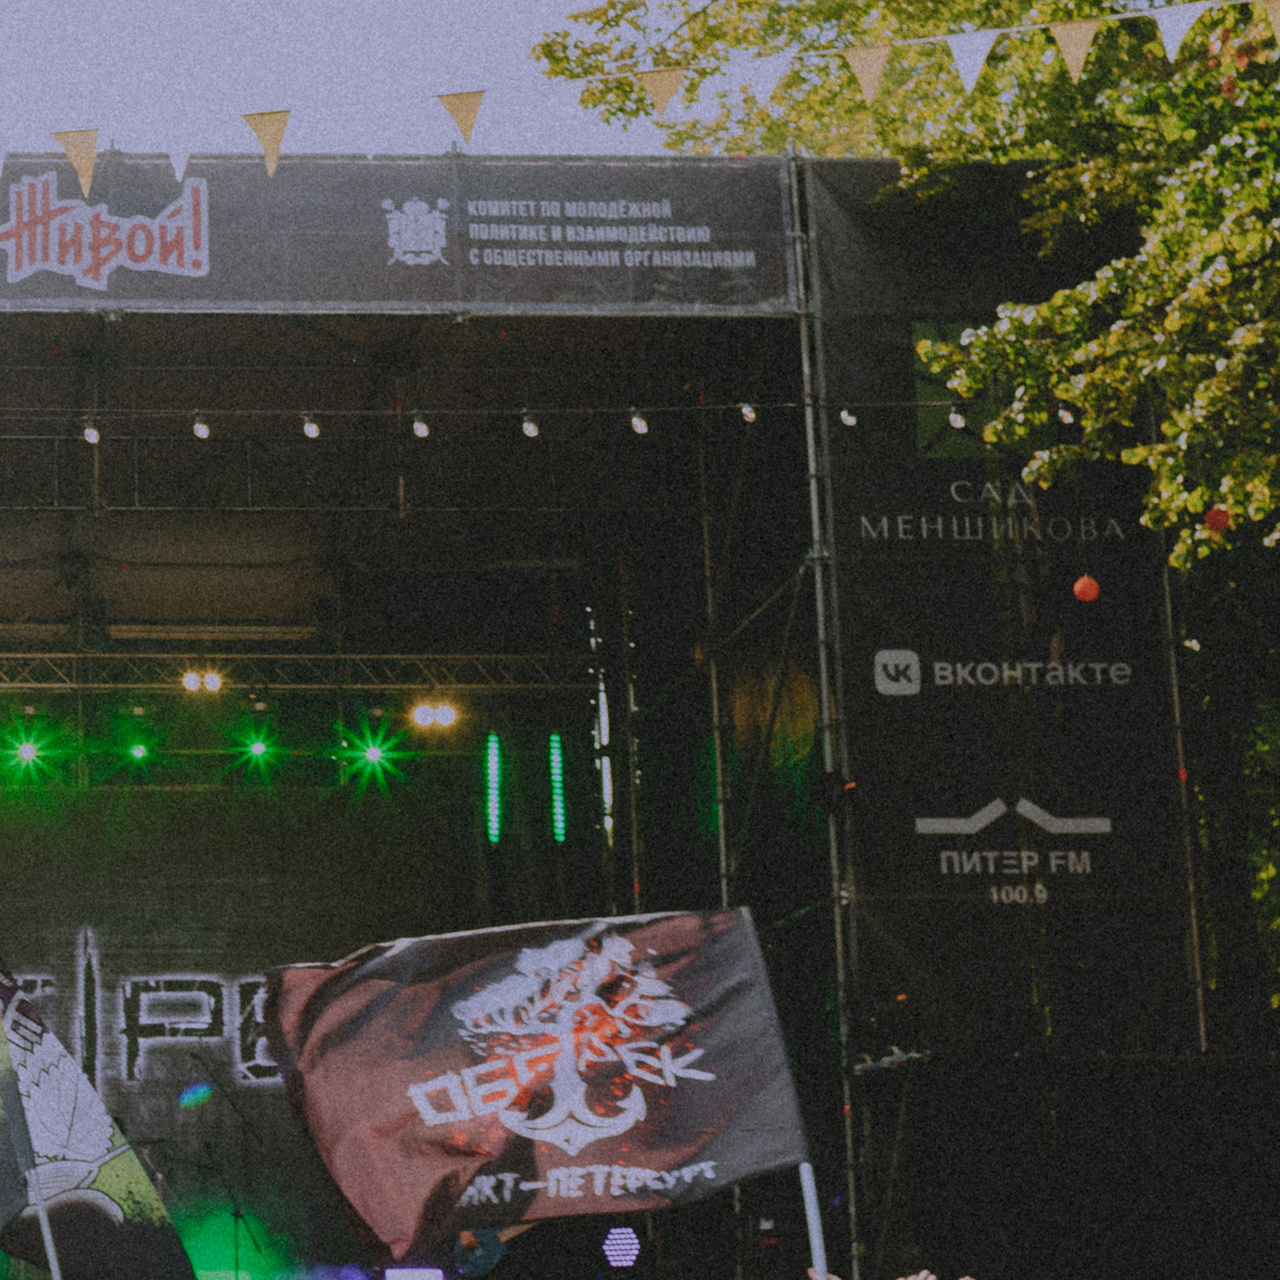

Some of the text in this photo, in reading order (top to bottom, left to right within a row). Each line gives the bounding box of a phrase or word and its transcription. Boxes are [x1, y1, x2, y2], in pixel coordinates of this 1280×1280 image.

[467, 198, 673, 219] КОМИТЕТ ПО МОЛОДЁЖНОЙ
[468, 223, 711, 243] ПОЛИТИКЕ И ВЗАИМОДЕЙСТВИЮ
[469, 248, 756, 269] С ОБЩЕСТВЕННЫМИ ОРГАНИЗАЦИЯМИ
[949, 480, 1033, 505] САД
[859, 515, 1126, 541] МЕНШИКОВА
[1049, 850, 1092, 875] FM
[989, 885, 1049, 905] 100.9
